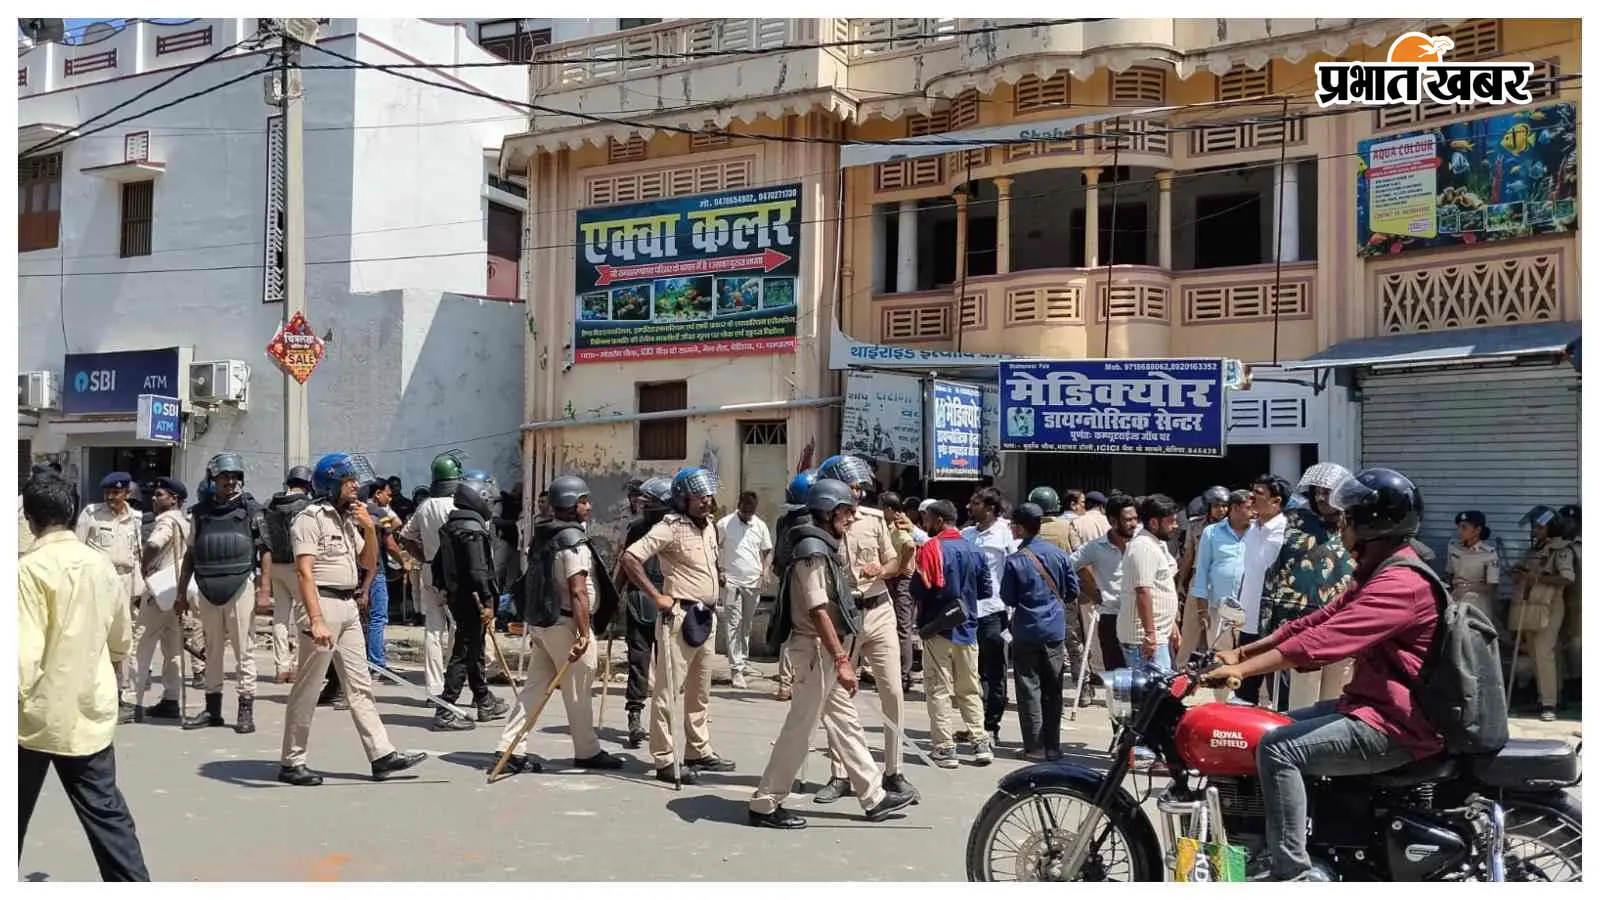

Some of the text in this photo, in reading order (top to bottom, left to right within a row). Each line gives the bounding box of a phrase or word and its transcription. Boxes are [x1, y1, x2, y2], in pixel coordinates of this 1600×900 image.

[580, 200, 797, 264] एक्वा कलर
[288, 354, 315, 364] SALE
[89, 370, 168, 391] SBI ATM
[1005, 371, 1217, 407] मेडिक्योर
[162, 402, 179, 417] SBI
[155, 420, 175, 432] ATM
[1041, 407, 1204, 431] डायग्नोस्टिक सेन्टर
[1212, 729, 1243, 740] ROYAL
[1210, 738, 1249, 749] ENFIELD
